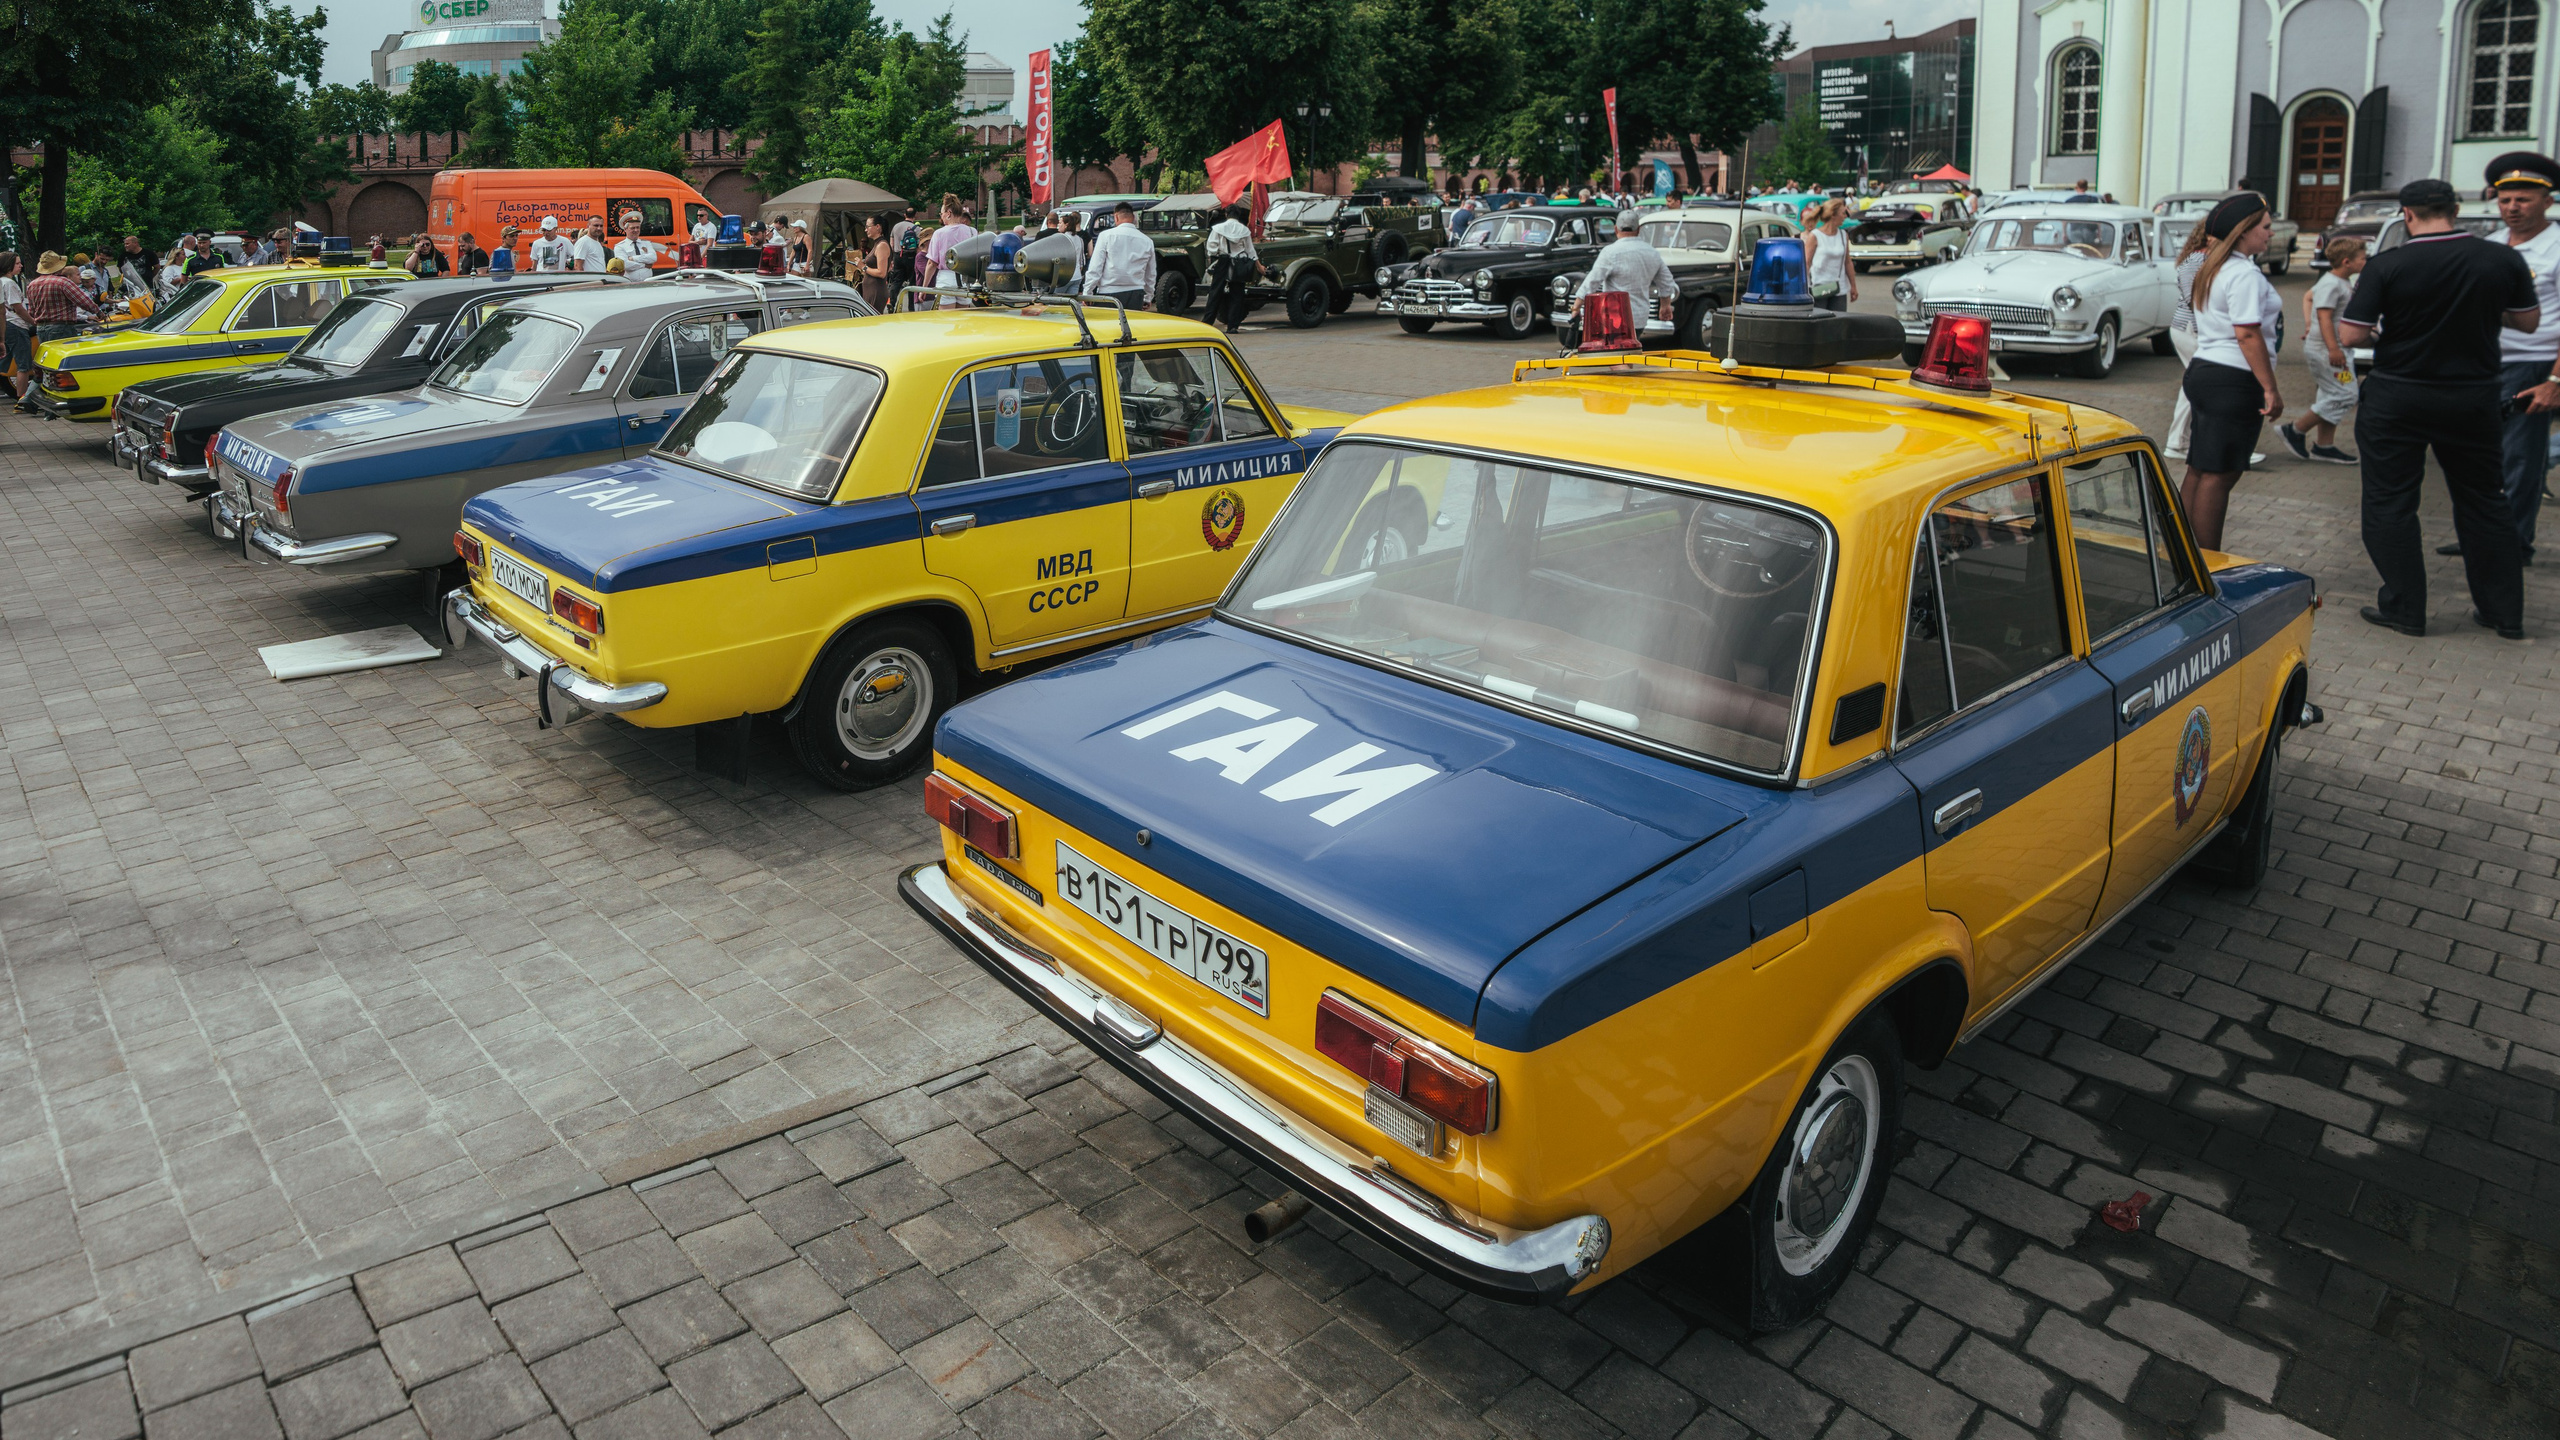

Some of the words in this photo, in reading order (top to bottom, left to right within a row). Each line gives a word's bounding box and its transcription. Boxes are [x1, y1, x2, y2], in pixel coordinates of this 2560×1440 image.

[440, 0, 489, 19] СБЕР
[1033, 70, 1050, 187] auto.ru
[497, 200, 590, 215] Лаборатория
[223, 436, 274, 477] МИЛИЦИЯ
[1177, 454, 1291, 487] МИЛИЦИЯ
[553, 478, 675, 518] ГАИ
[1037, 548, 1093, 581] МВД
[1028, 580, 1099, 614] СССР
[2153, 632, 2231, 709] МИЛИЦИЯ
[1120, 690, 1441, 828] ГАИ
[969, 851, 1005, 881] LADA
[1011, 879, 1037, 900] 1300
[1066, 862, 1188, 960] В151ТР
[1196, 925, 1255, 985] 799
[1212, 969, 1240, 995] RUS
